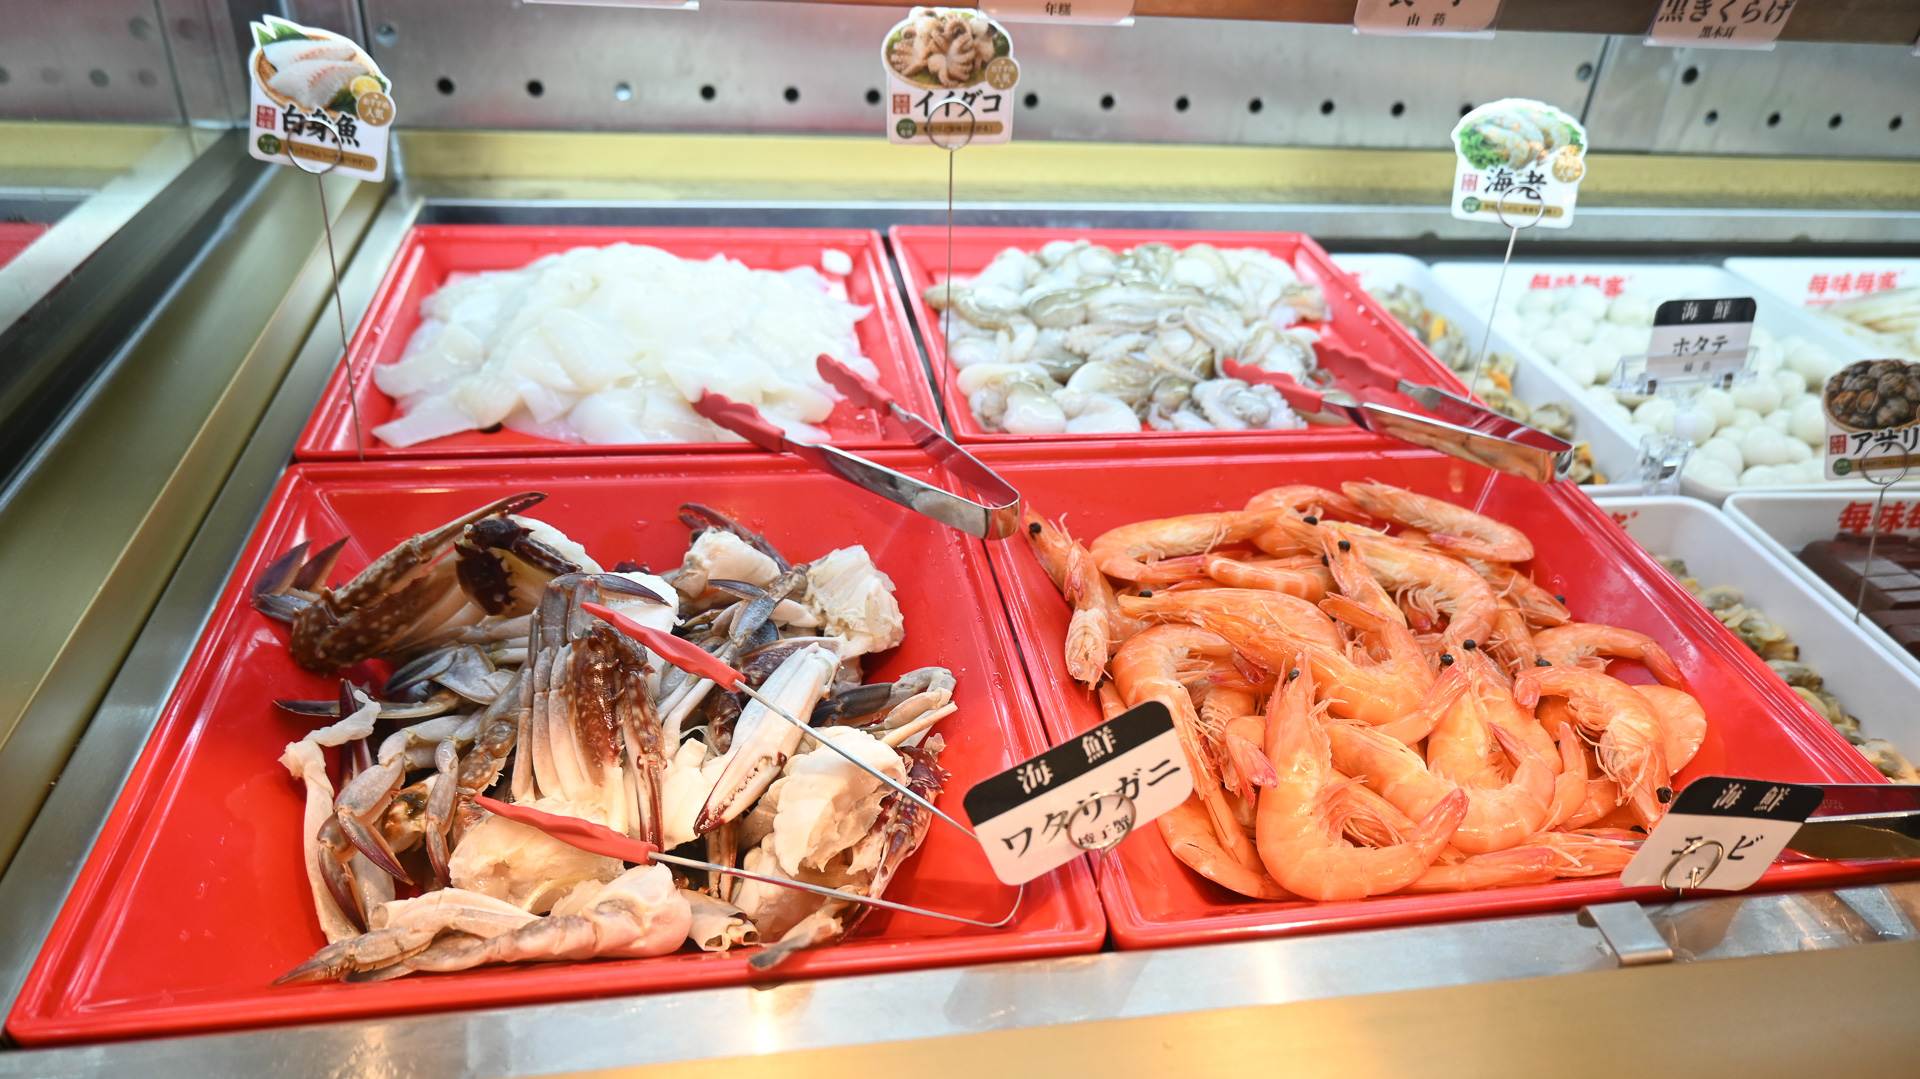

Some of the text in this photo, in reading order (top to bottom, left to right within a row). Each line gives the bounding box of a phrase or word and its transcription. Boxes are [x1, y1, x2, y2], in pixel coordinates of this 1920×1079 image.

[914, 89, 1002, 118] イイダコ
[282, 103, 360, 148] 白身魚
[1484, 168, 1547, 201] 海老
[1681, 299, 1732, 321] 海鮮
[1672, 334, 1729, 357] ホタテ
[1850, 427, 1919, 456] アサリ
[1016, 725, 1118, 795] 海鮮
[1001, 758, 1181, 859] ワタリガニ
[1712, 782, 1791, 812] 海鮮
[1671, 834, 1764, 860] エビ
